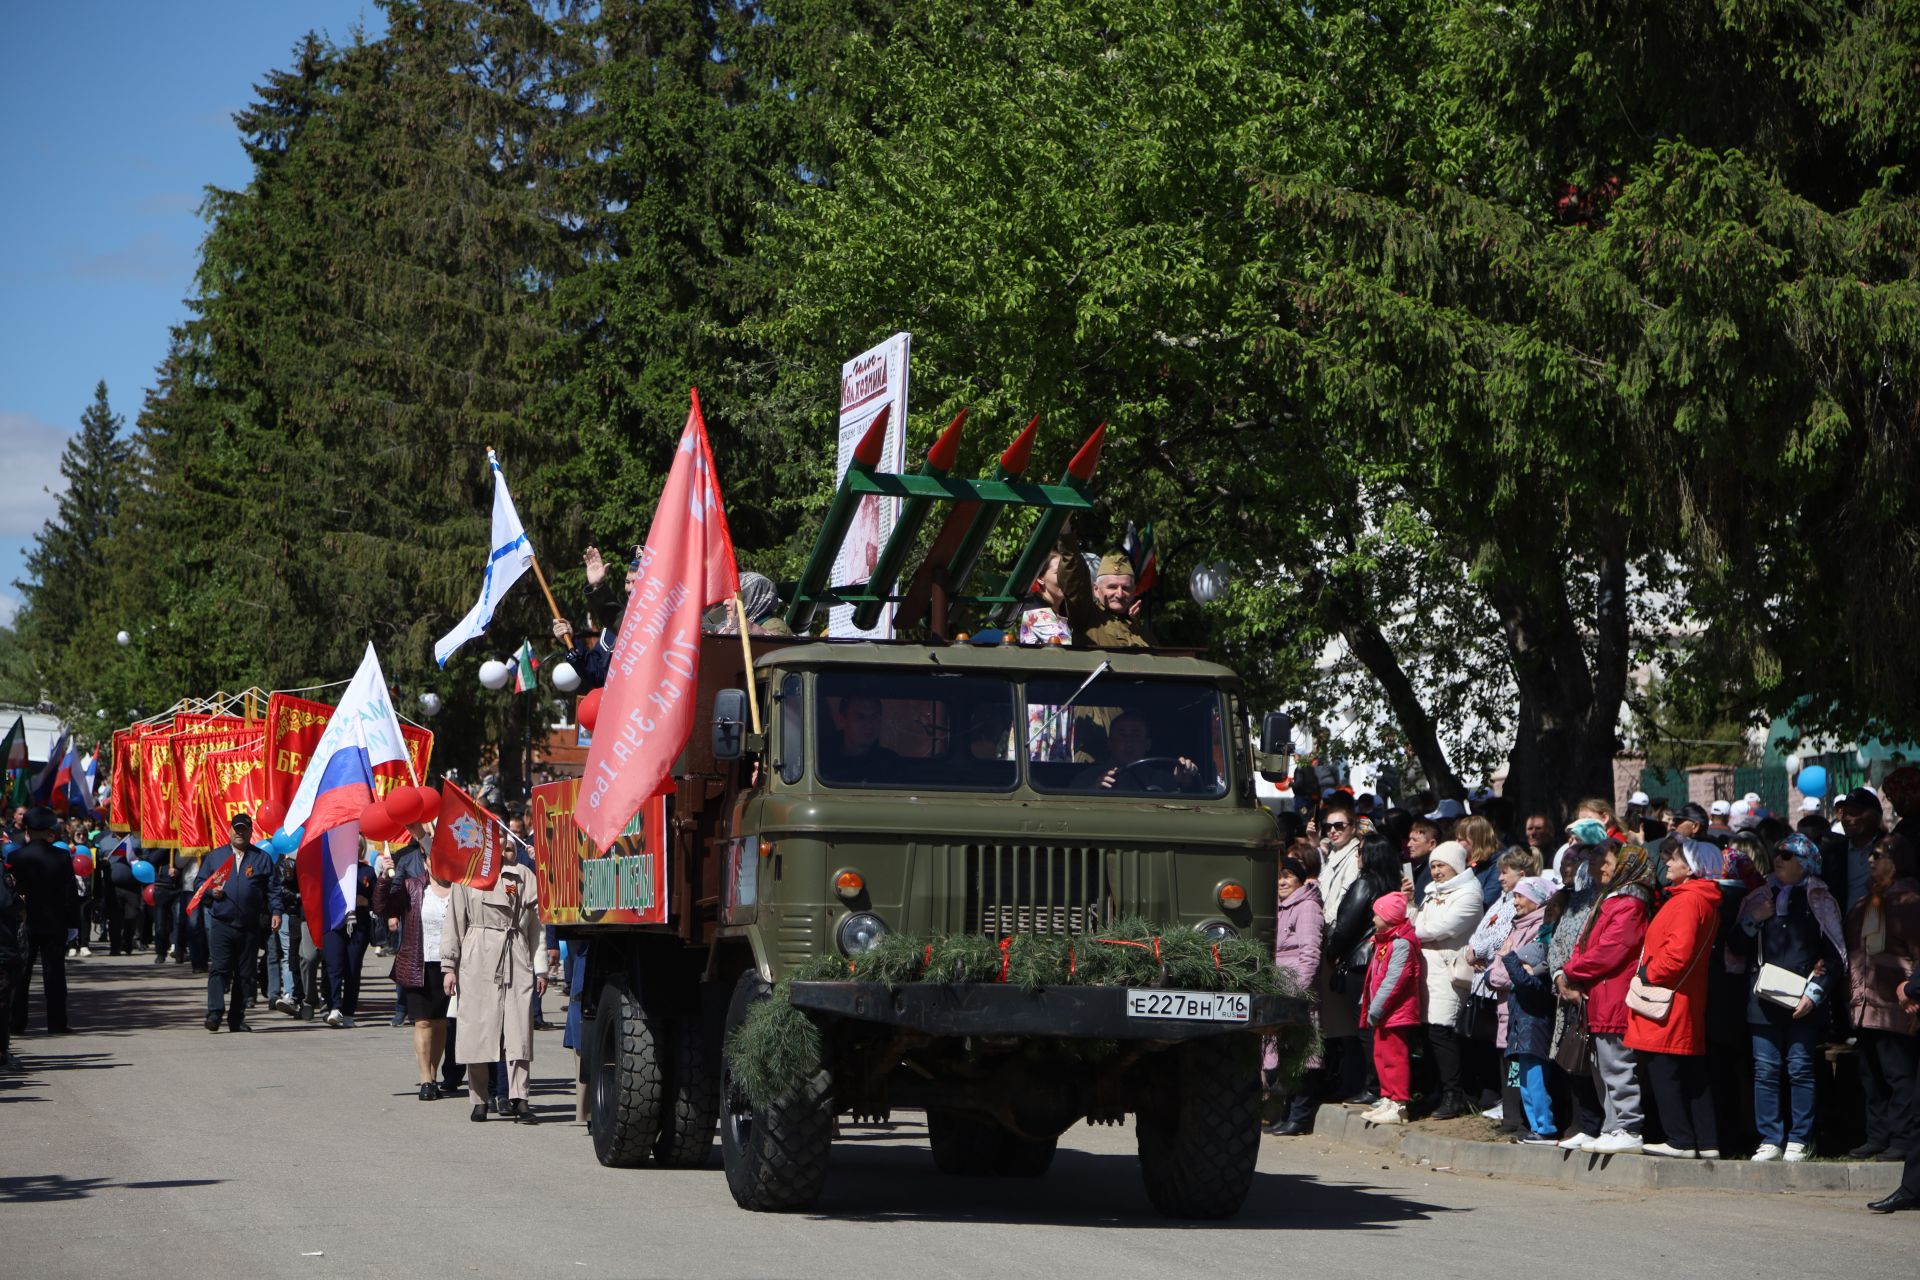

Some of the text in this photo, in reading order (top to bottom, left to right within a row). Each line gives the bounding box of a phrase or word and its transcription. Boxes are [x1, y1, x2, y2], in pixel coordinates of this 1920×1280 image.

[583, 847, 655, 916] ВЕЛИКОЙ ПОБЕДЫ!
[1135, 994, 1245, 1017] Е227ВН 716
